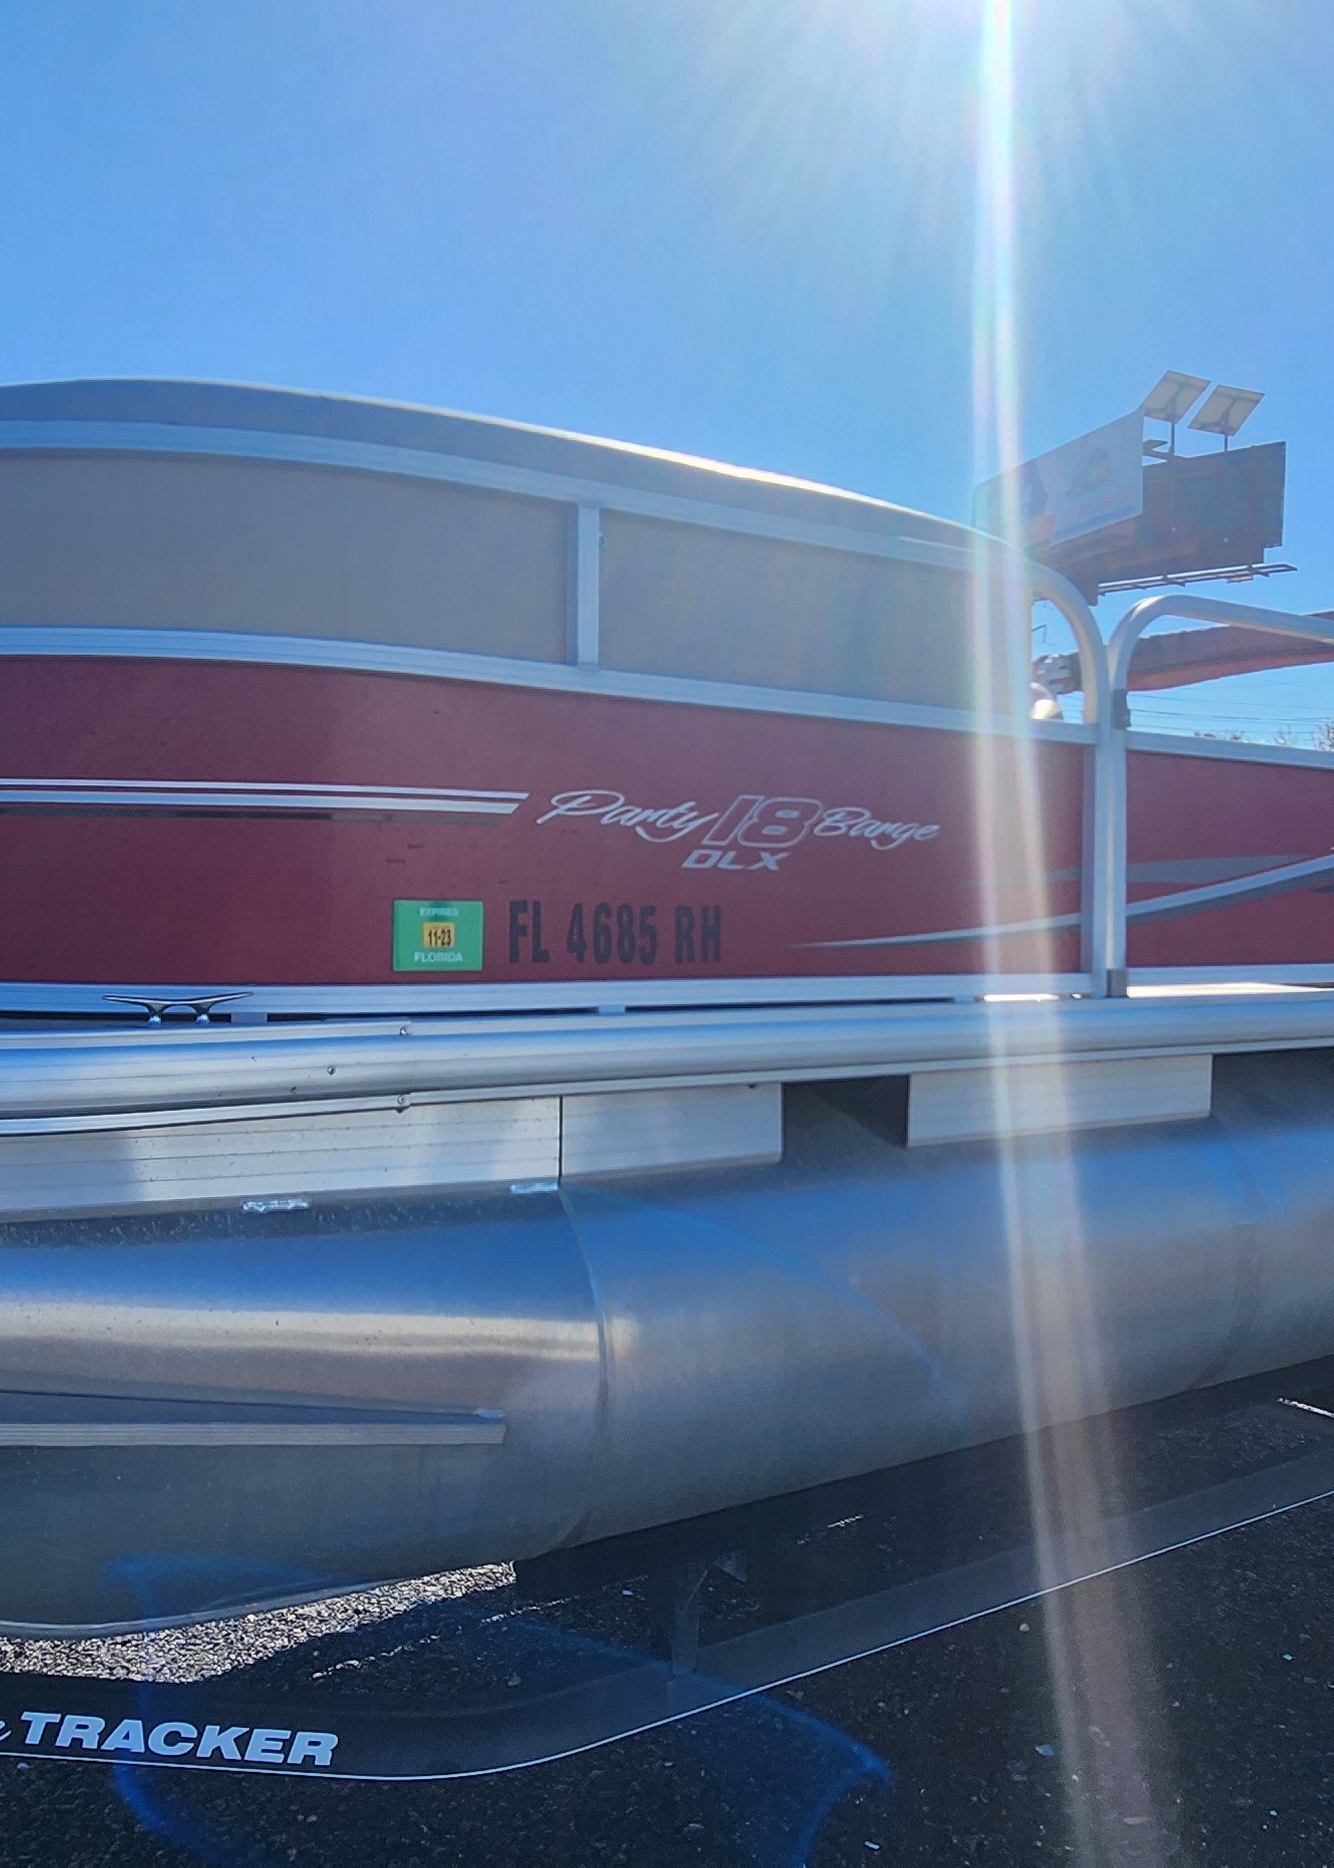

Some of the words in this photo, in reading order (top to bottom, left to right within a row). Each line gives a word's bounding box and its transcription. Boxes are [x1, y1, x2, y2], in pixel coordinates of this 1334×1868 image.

[536, 789, 720, 843] Party
[701, 795, 824, 848] 18
[813, 806, 942, 851] Barge
[681, 848, 790, 872] DLX
[413, 951, 464, 963] FLORIDA
[509, 900, 550, 964] FL
[569, 902, 658, 966] 4685
[674, 904, 723, 965] RH
[19, 1711, 340, 1767] TRACKER
